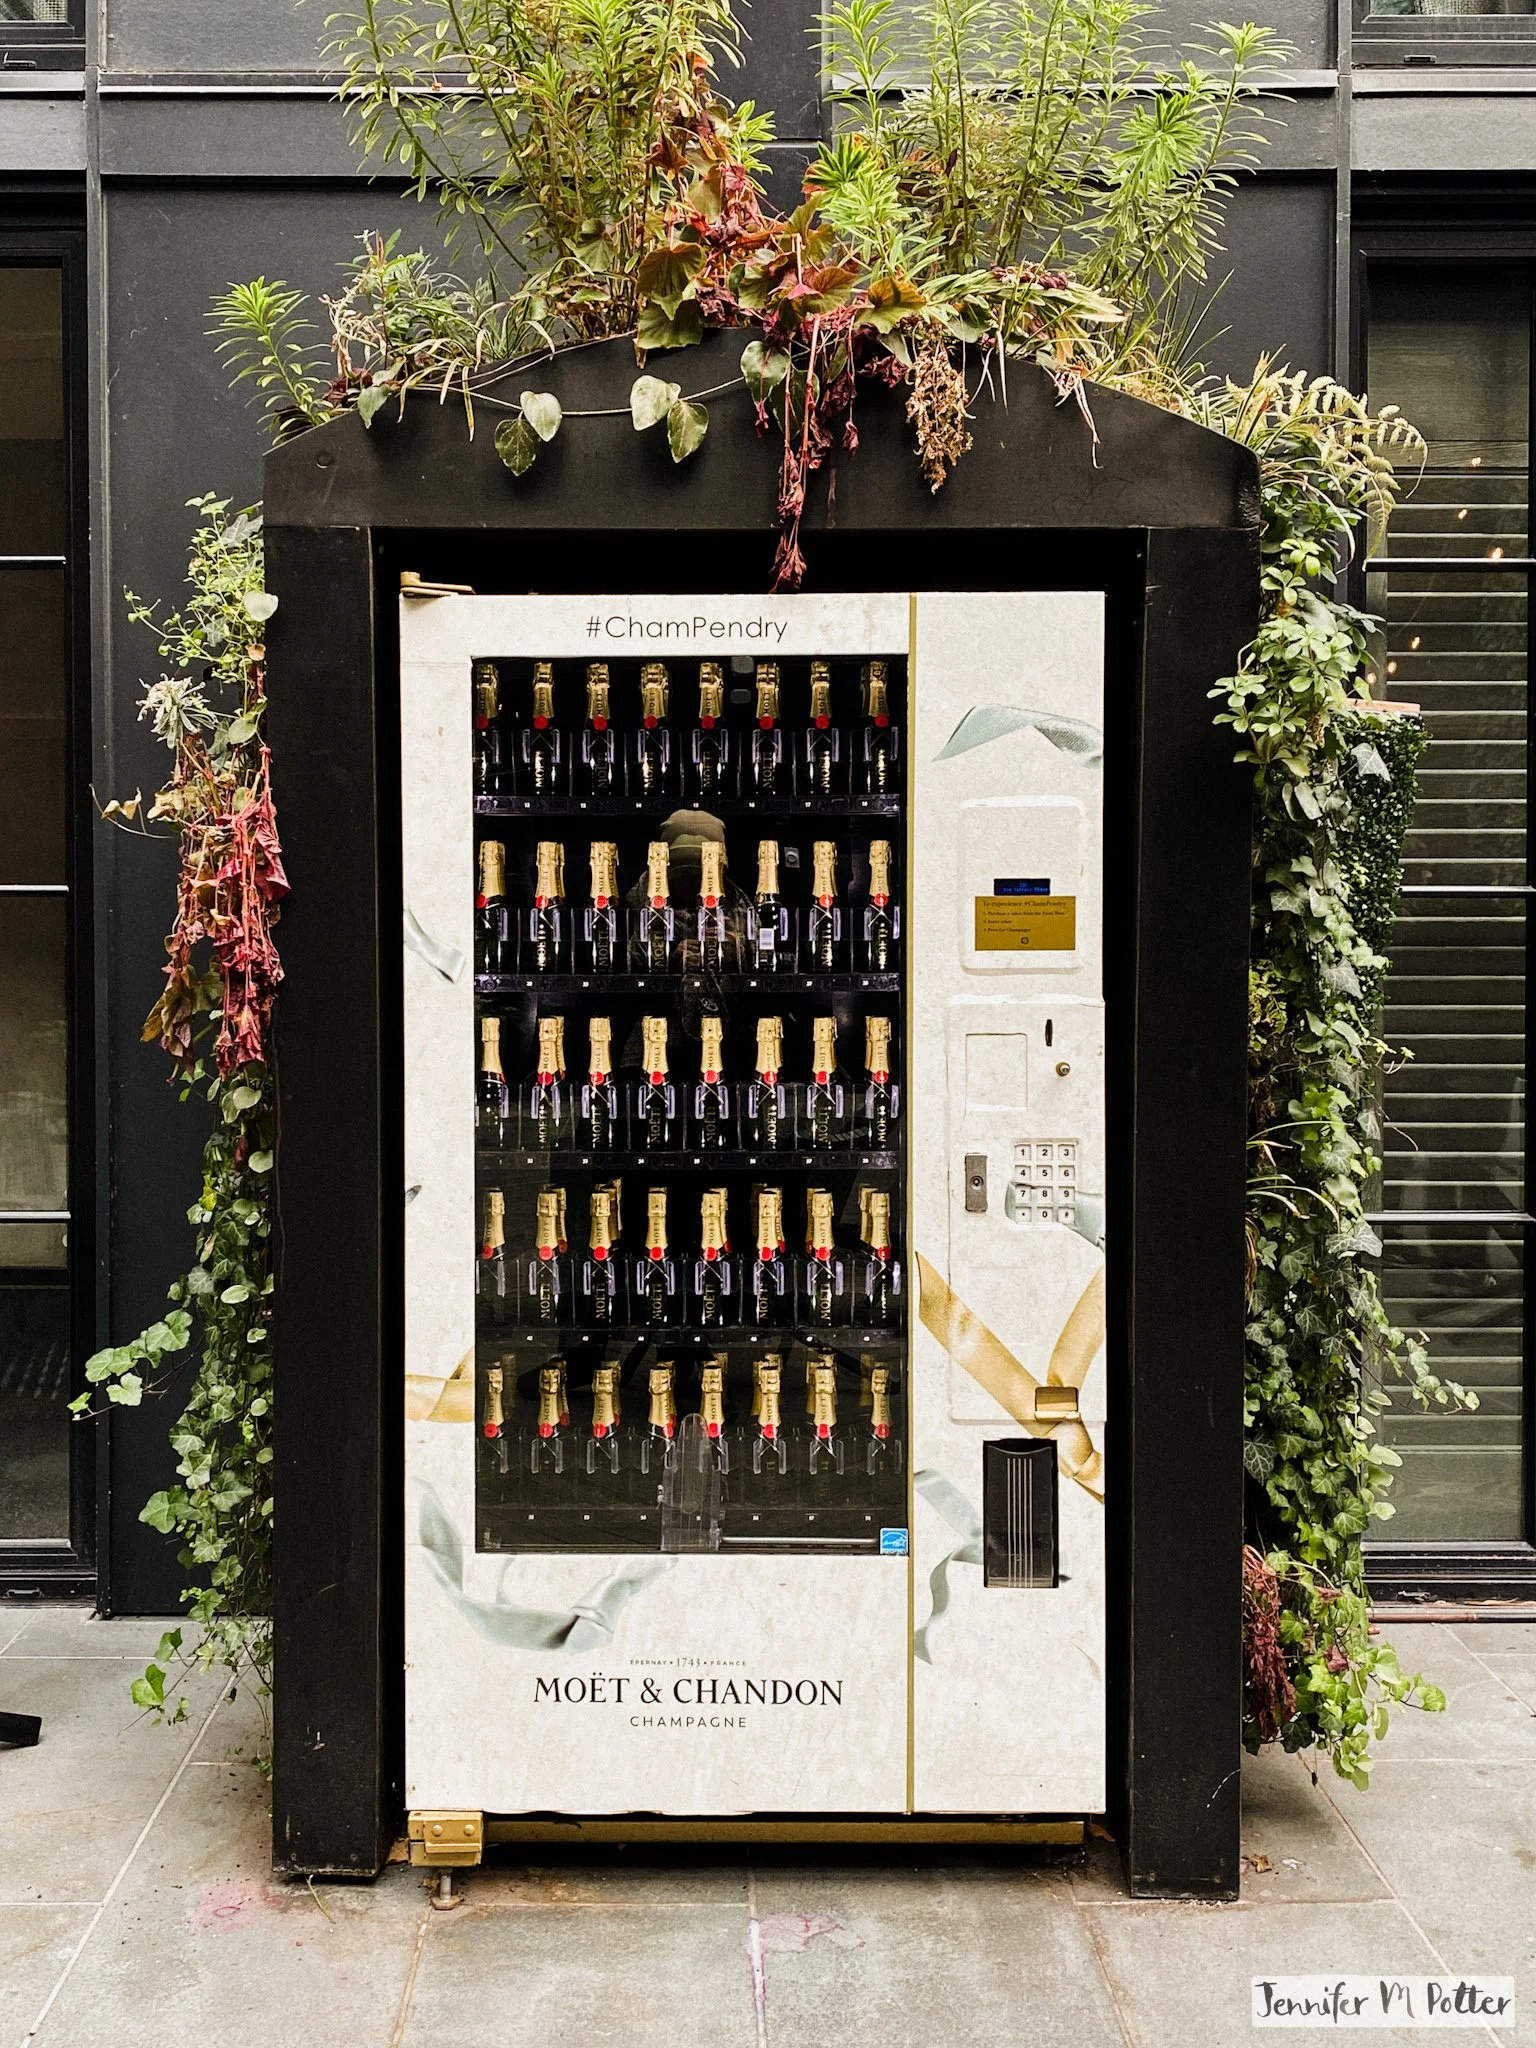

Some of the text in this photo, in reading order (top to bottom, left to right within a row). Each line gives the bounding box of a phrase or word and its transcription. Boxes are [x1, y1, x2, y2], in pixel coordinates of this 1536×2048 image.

[587, 616, 788, 643] #ChamPendry
[677, 1657, 701, 1667] 1743
[534, 1672, 844, 1706] MOËT & CHANDON
[630, 1716, 746, 1728] CHAMPAGNE
